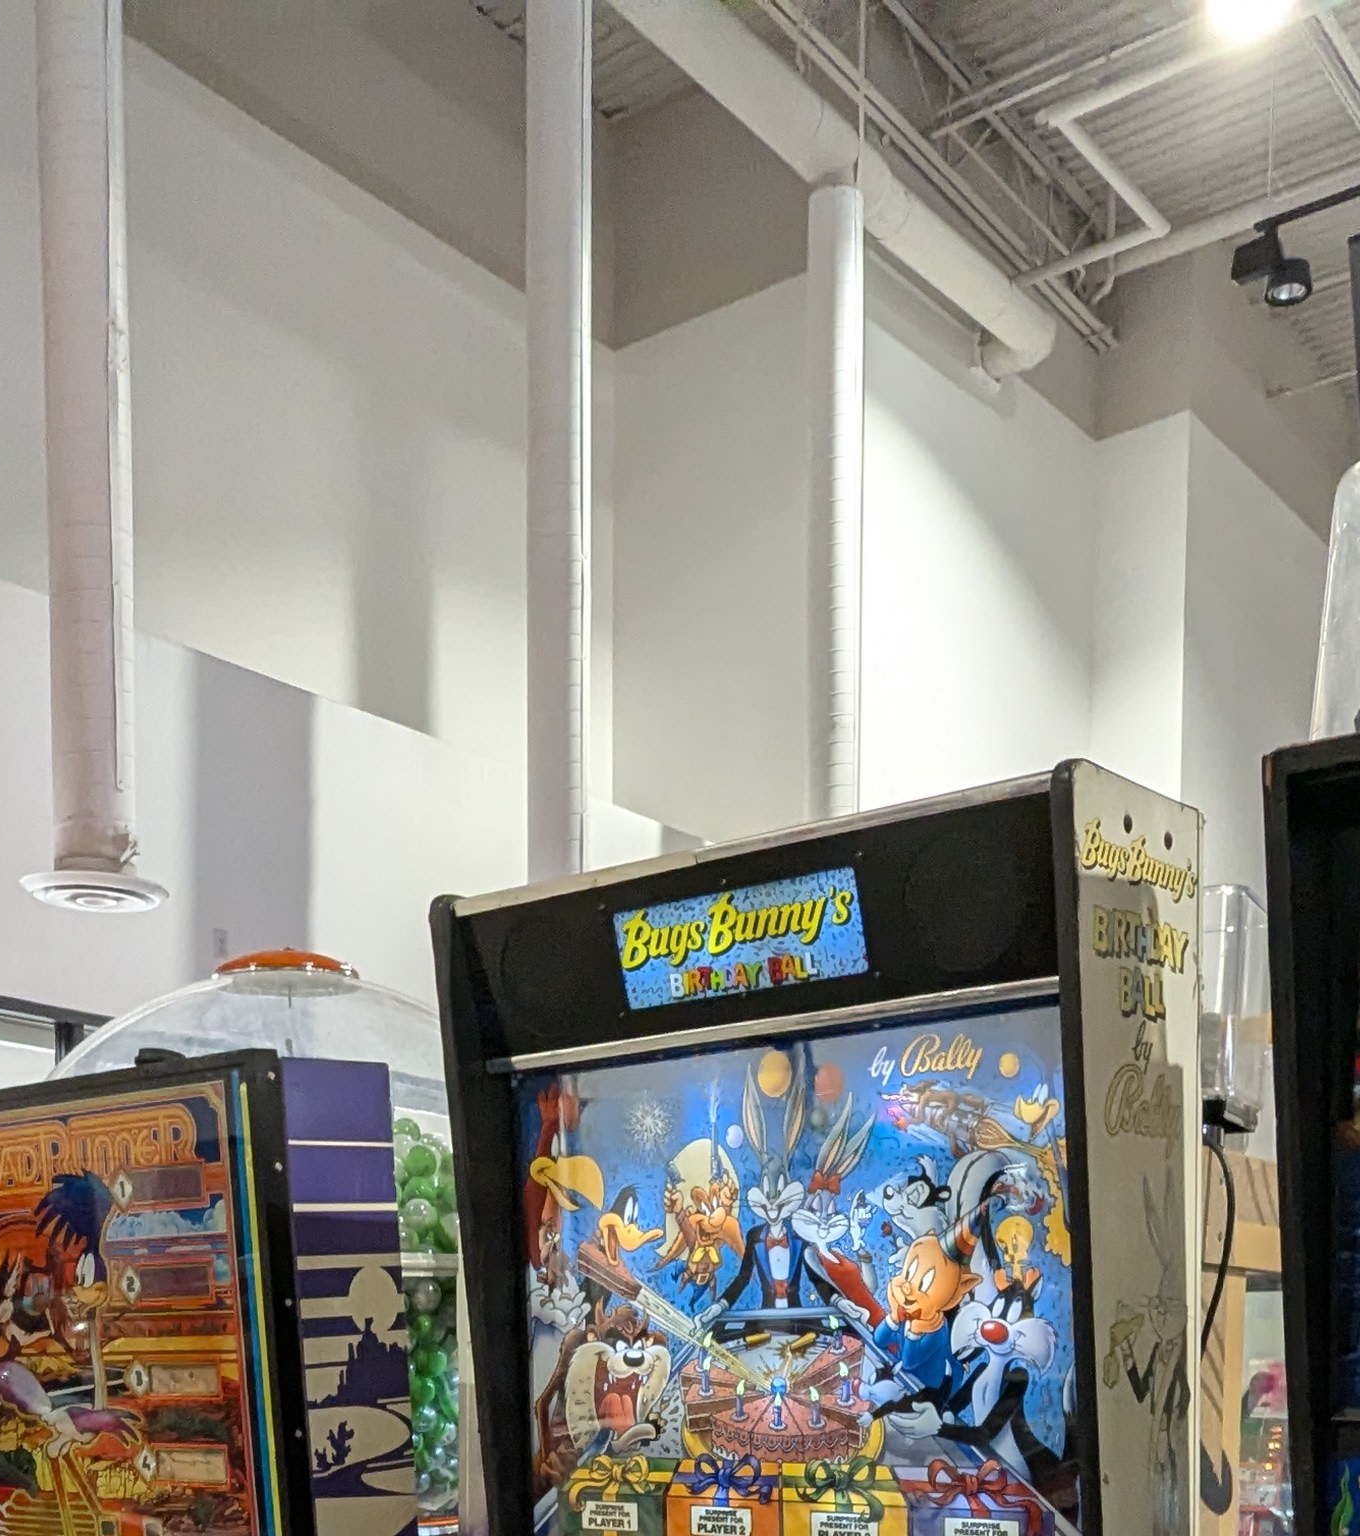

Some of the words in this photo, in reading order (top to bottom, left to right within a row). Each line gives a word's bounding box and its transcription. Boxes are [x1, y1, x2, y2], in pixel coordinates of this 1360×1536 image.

[1081, 817, 1129, 882] Bugs
[1127, 835, 1197, 903] Bunny's
[621, 908, 706, 969] Bugs
[707, 886, 852, 955] Bunny's
[1093, 904, 1189, 974] BIRTHDAY
[669, 963, 762, 998] BIRTHDAY
[767, 951, 820, 986] BALL
[1119, 966, 1166, 1023] BALL
[868, 1046, 895, 1086] by
[900, 1033, 984, 1080] Bally
[1133, 1021, 1153, 1076] by
[1104, 1063, 1183, 1148] Bally
[588, 1518, 625, 1529] PLAYER
[697, 1523, 738, 1535] PLAYER
[739, 1525, 747, 1536] 2
[954, 1528, 991, 1536] PRESENT
[991, 1529, 1009, 1536] FOR
[960, 1521, 1001, 1530] SURPRISE
